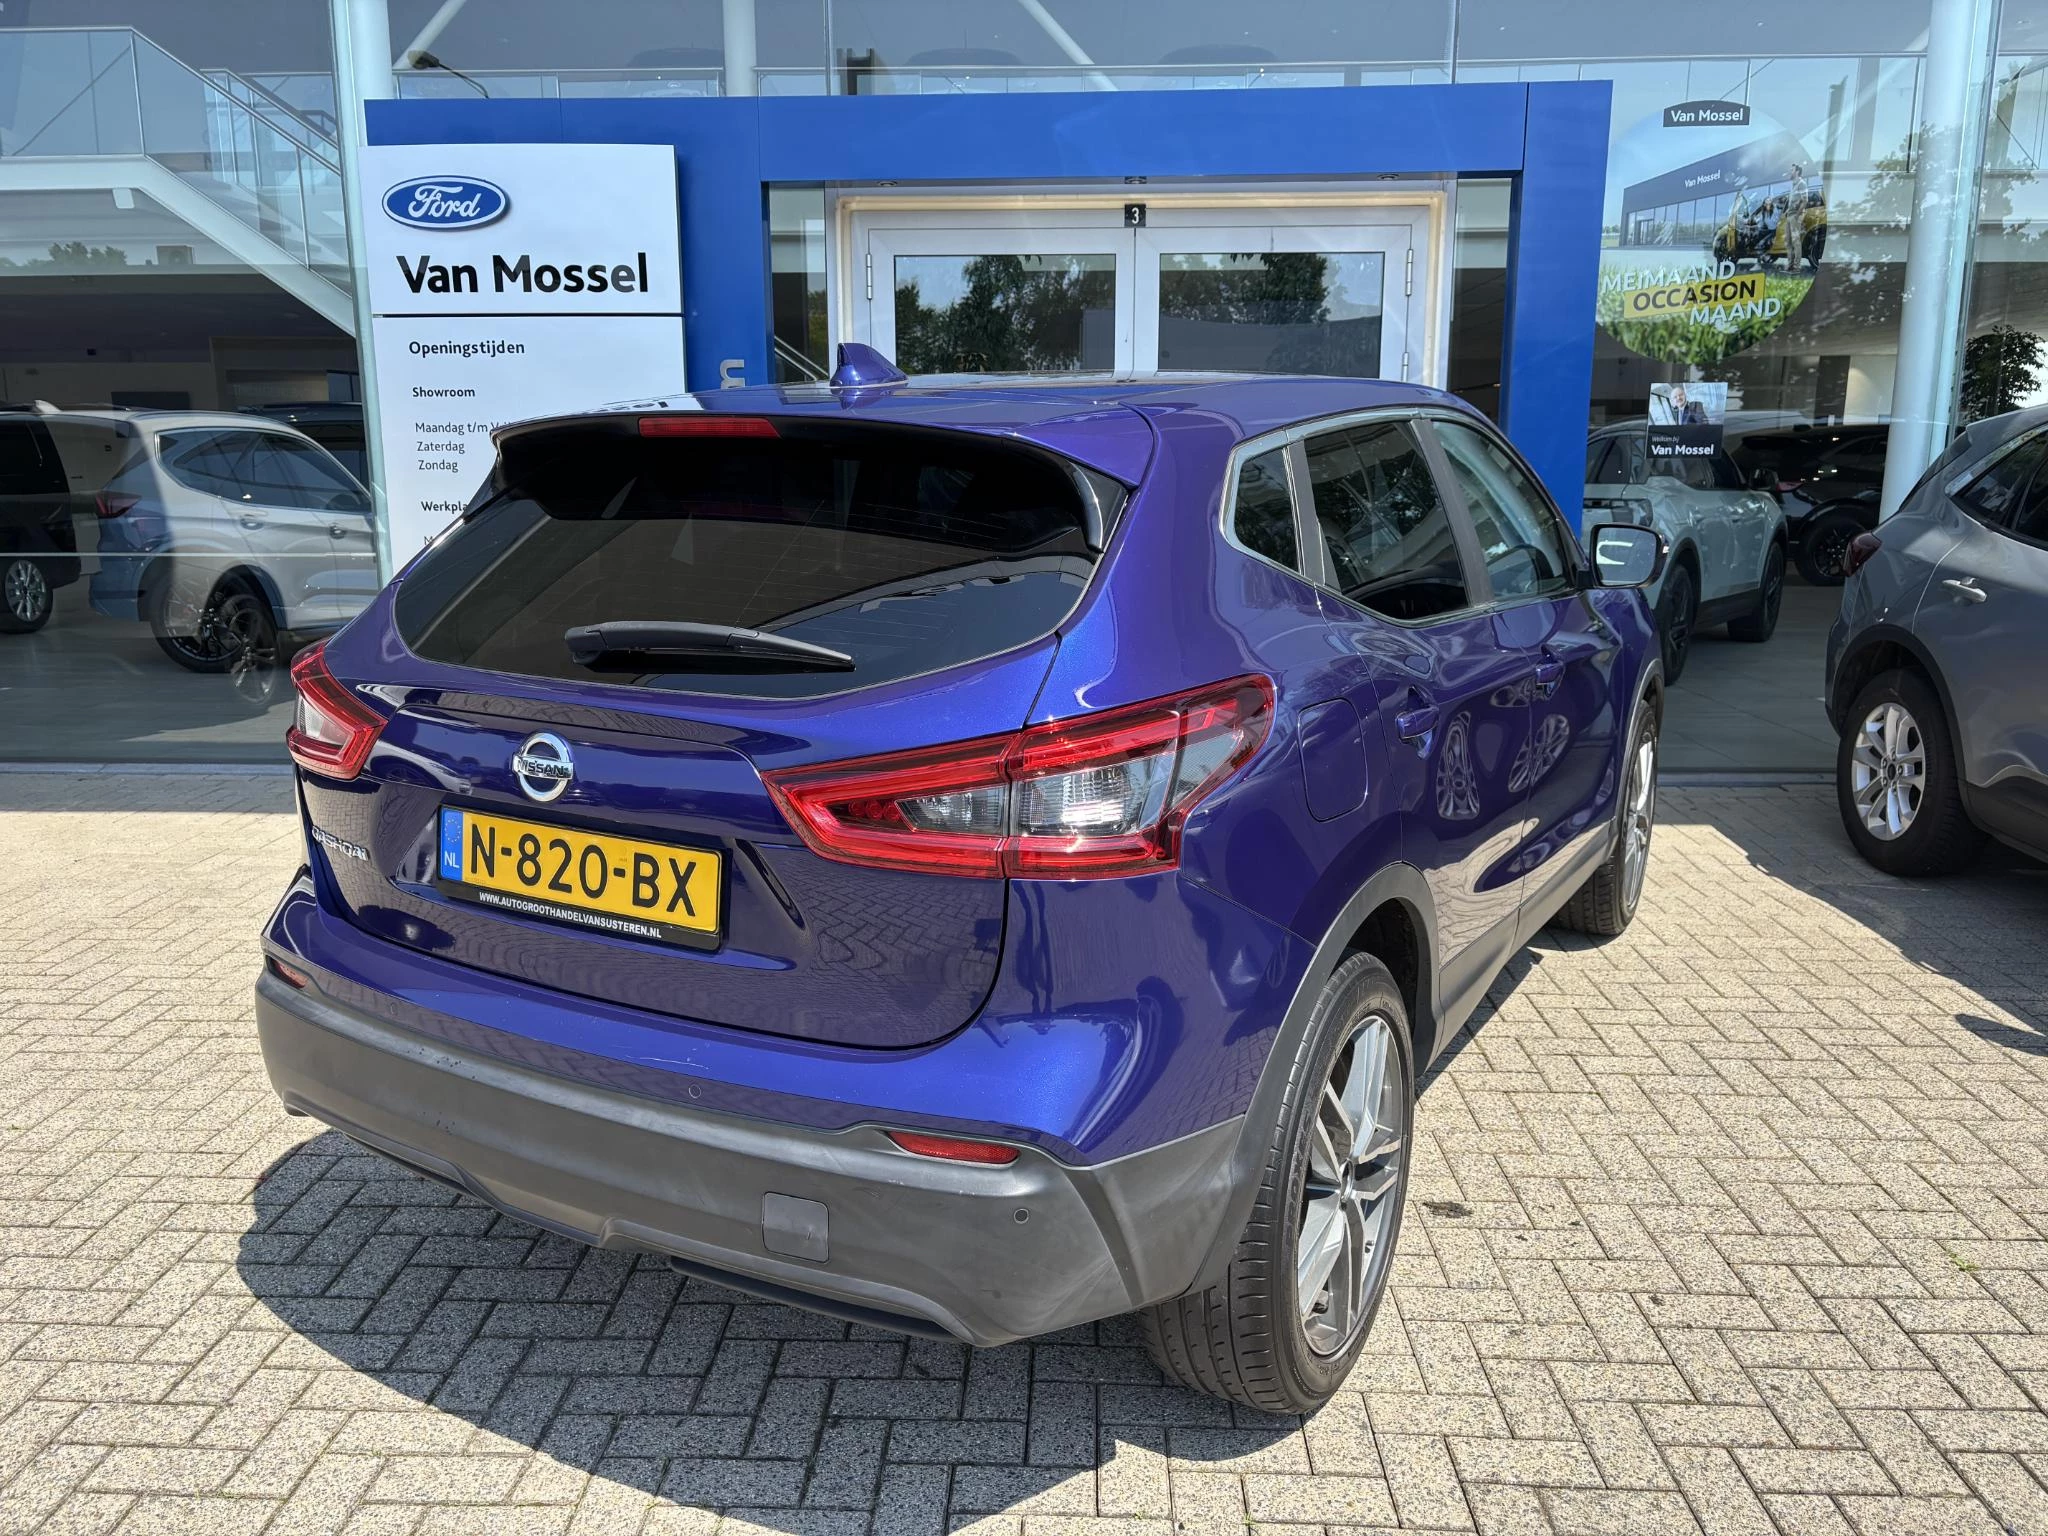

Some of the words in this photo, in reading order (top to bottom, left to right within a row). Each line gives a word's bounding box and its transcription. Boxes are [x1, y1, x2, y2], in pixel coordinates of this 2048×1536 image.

[1671, 110, 1695, 122] Van
[1698, 108, 1744, 121] Mossel
[407, 184, 481, 219] Ford
[1131, 207, 1140, 224] 3
[396, 254, 479, 294] Van
[492, 252, 648, 294] Mossel
[1601, 260, 1736, 294] MEIMAAND
[1633, 280, 1756, 311] OCCASION
[1690, 298, 1782, 326] MAAND
[408, 340, 526, 359] Openingstijden
[412, 386, 476, 398] Showroom
[415, 422, 465, 435] Maandag
[467, 422, 488, 433] t/m
[416, 441, 465, 454] Zaterdag
[1651, 444, 1672, 455] Van
[1675, 443, 1715, 455] Mossel
[418, 459, 458, 473] Zondag
[517, 759, 564, 777] NISSAN
[444, 851, 460, 869] NL
[470, 823, 697, 918] N-820-BX
[479, 891, 662, 939] WWW.AUTOGROOTHANDELVANSUSTEREN.NL
